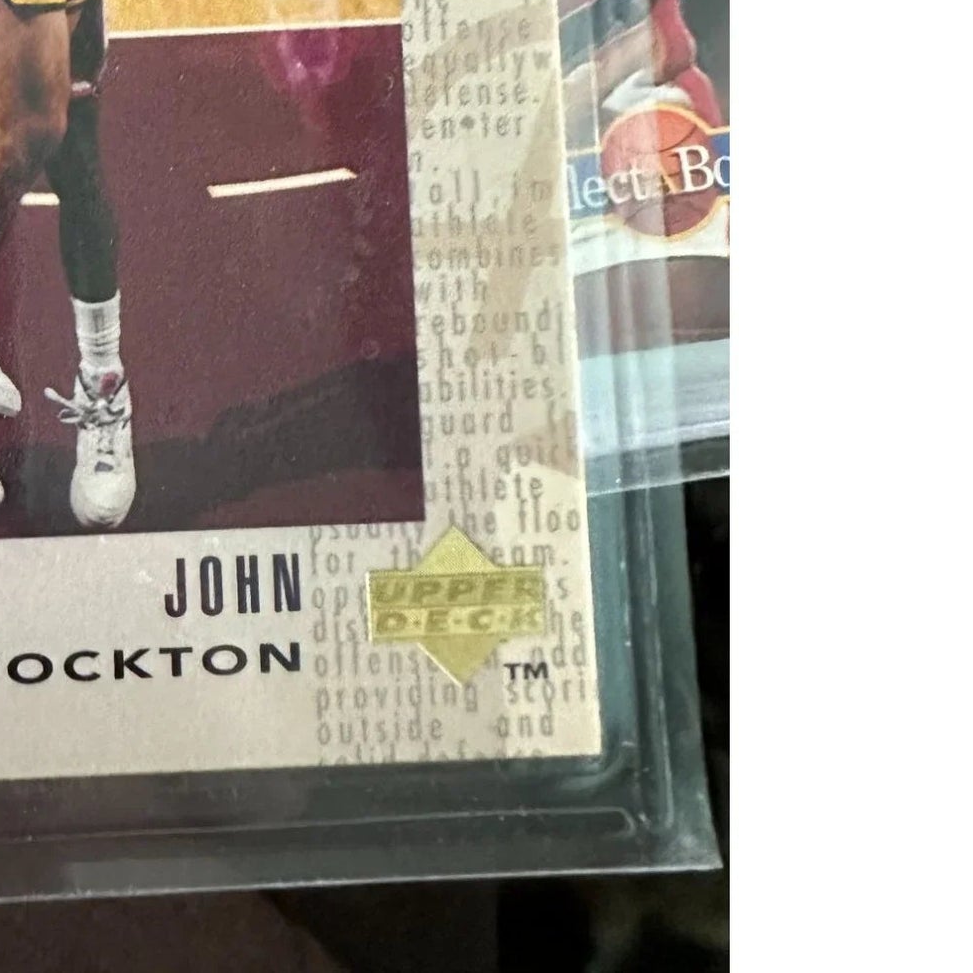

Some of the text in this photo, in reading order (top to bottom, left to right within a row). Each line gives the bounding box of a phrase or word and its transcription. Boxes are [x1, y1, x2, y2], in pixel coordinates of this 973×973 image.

[491, 545, 570, 567] eam.
[163, 552, 302, 618] JOHN
[375, 577, 542, 605] UPPER
[504, 663, 548, 680] TM
